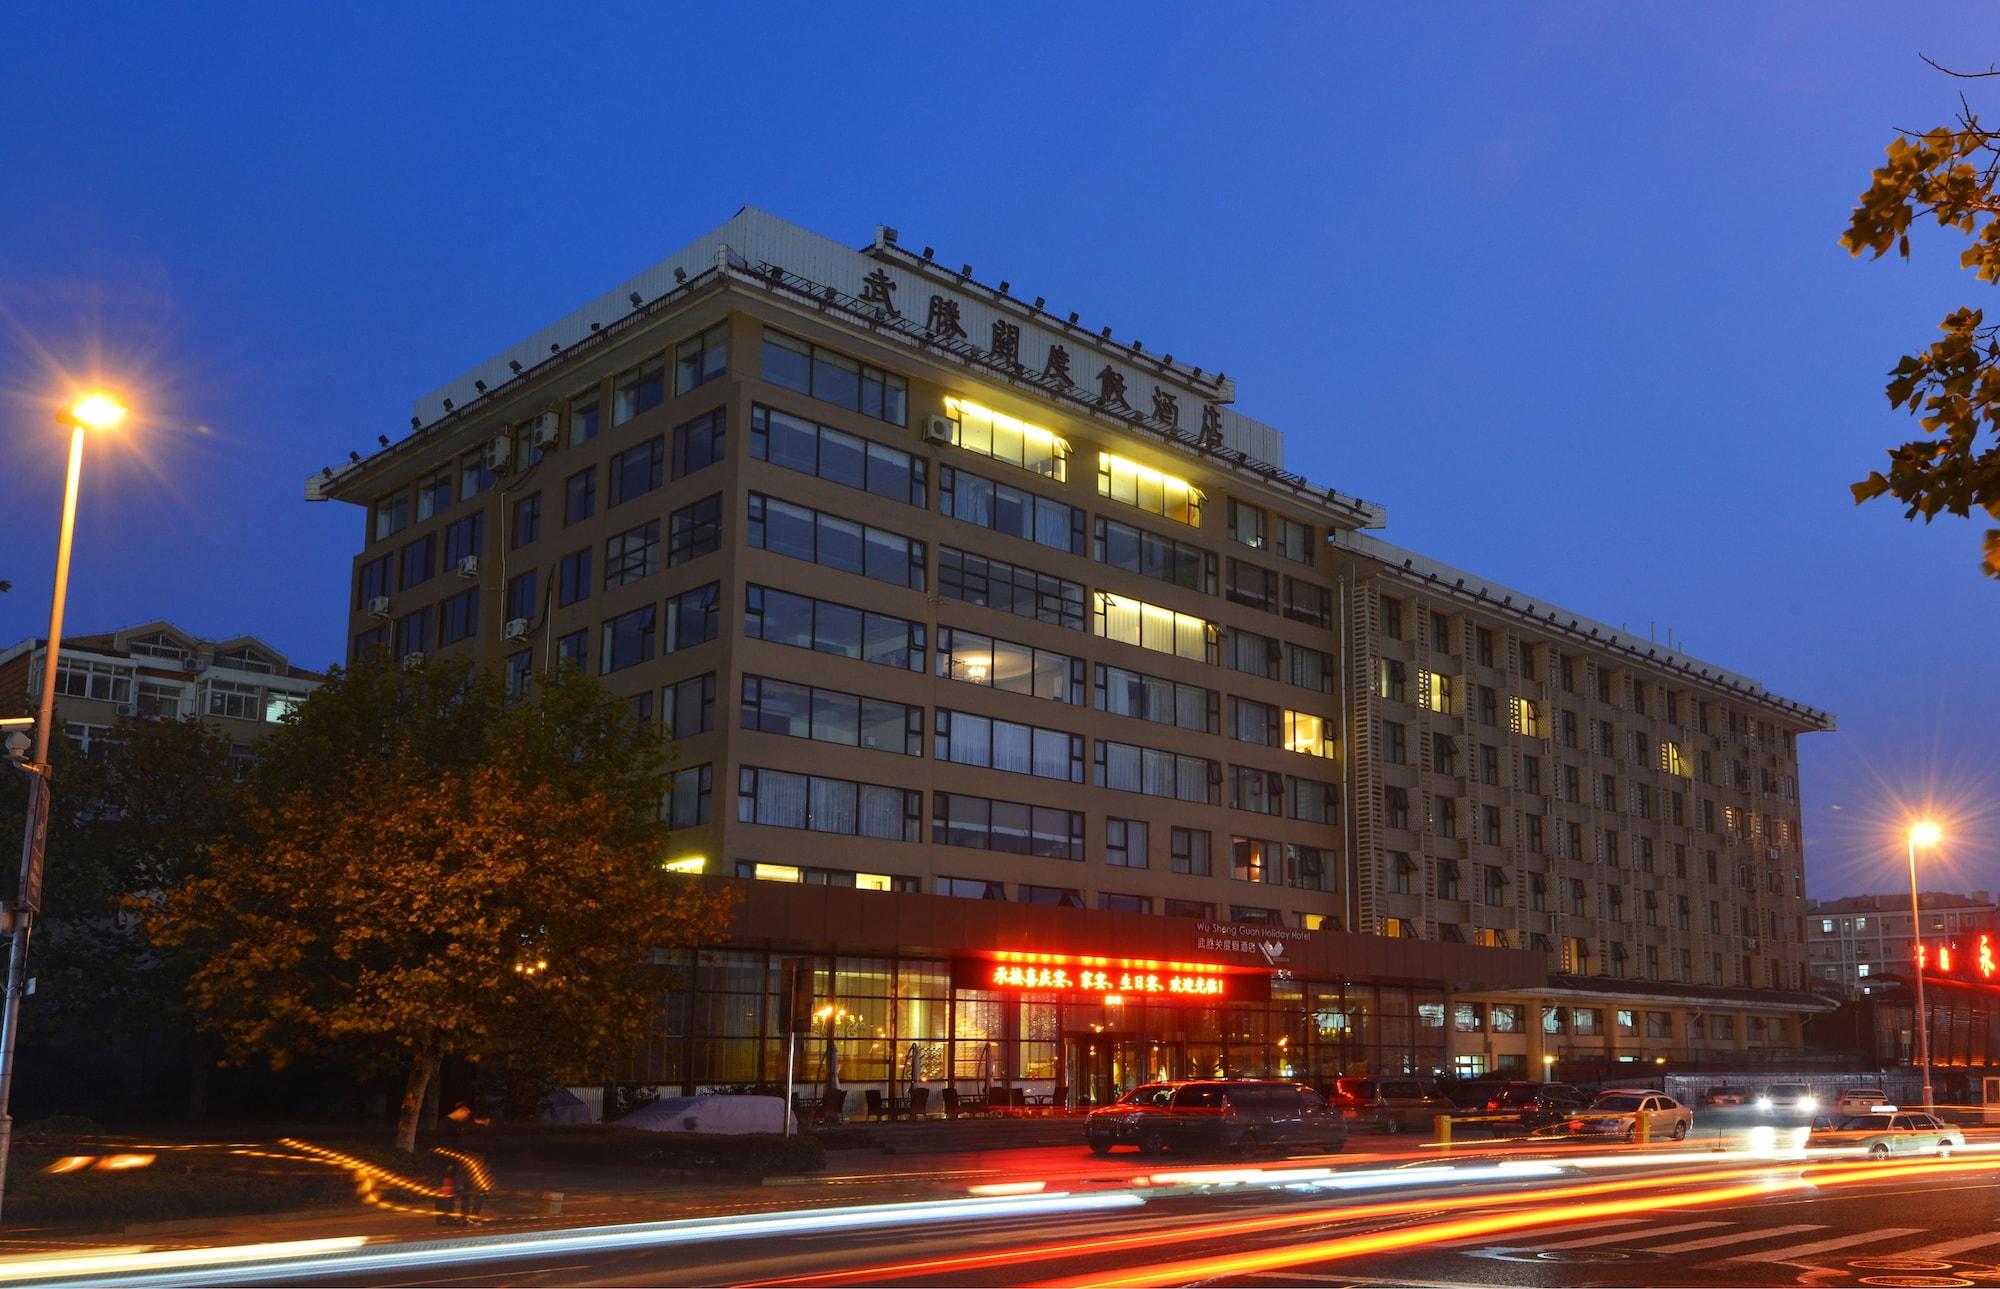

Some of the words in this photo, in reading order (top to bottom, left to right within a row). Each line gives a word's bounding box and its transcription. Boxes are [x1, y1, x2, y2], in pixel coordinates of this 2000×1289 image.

[1197, 922, 1210, 932] Wu
[1213, 923, 1237, 936] Sheng
[1239, 926, 1260, 936] Guan
[1262, 928, 1290, 940] Holiday
[1292, 931, 1311, 941] Hotel
